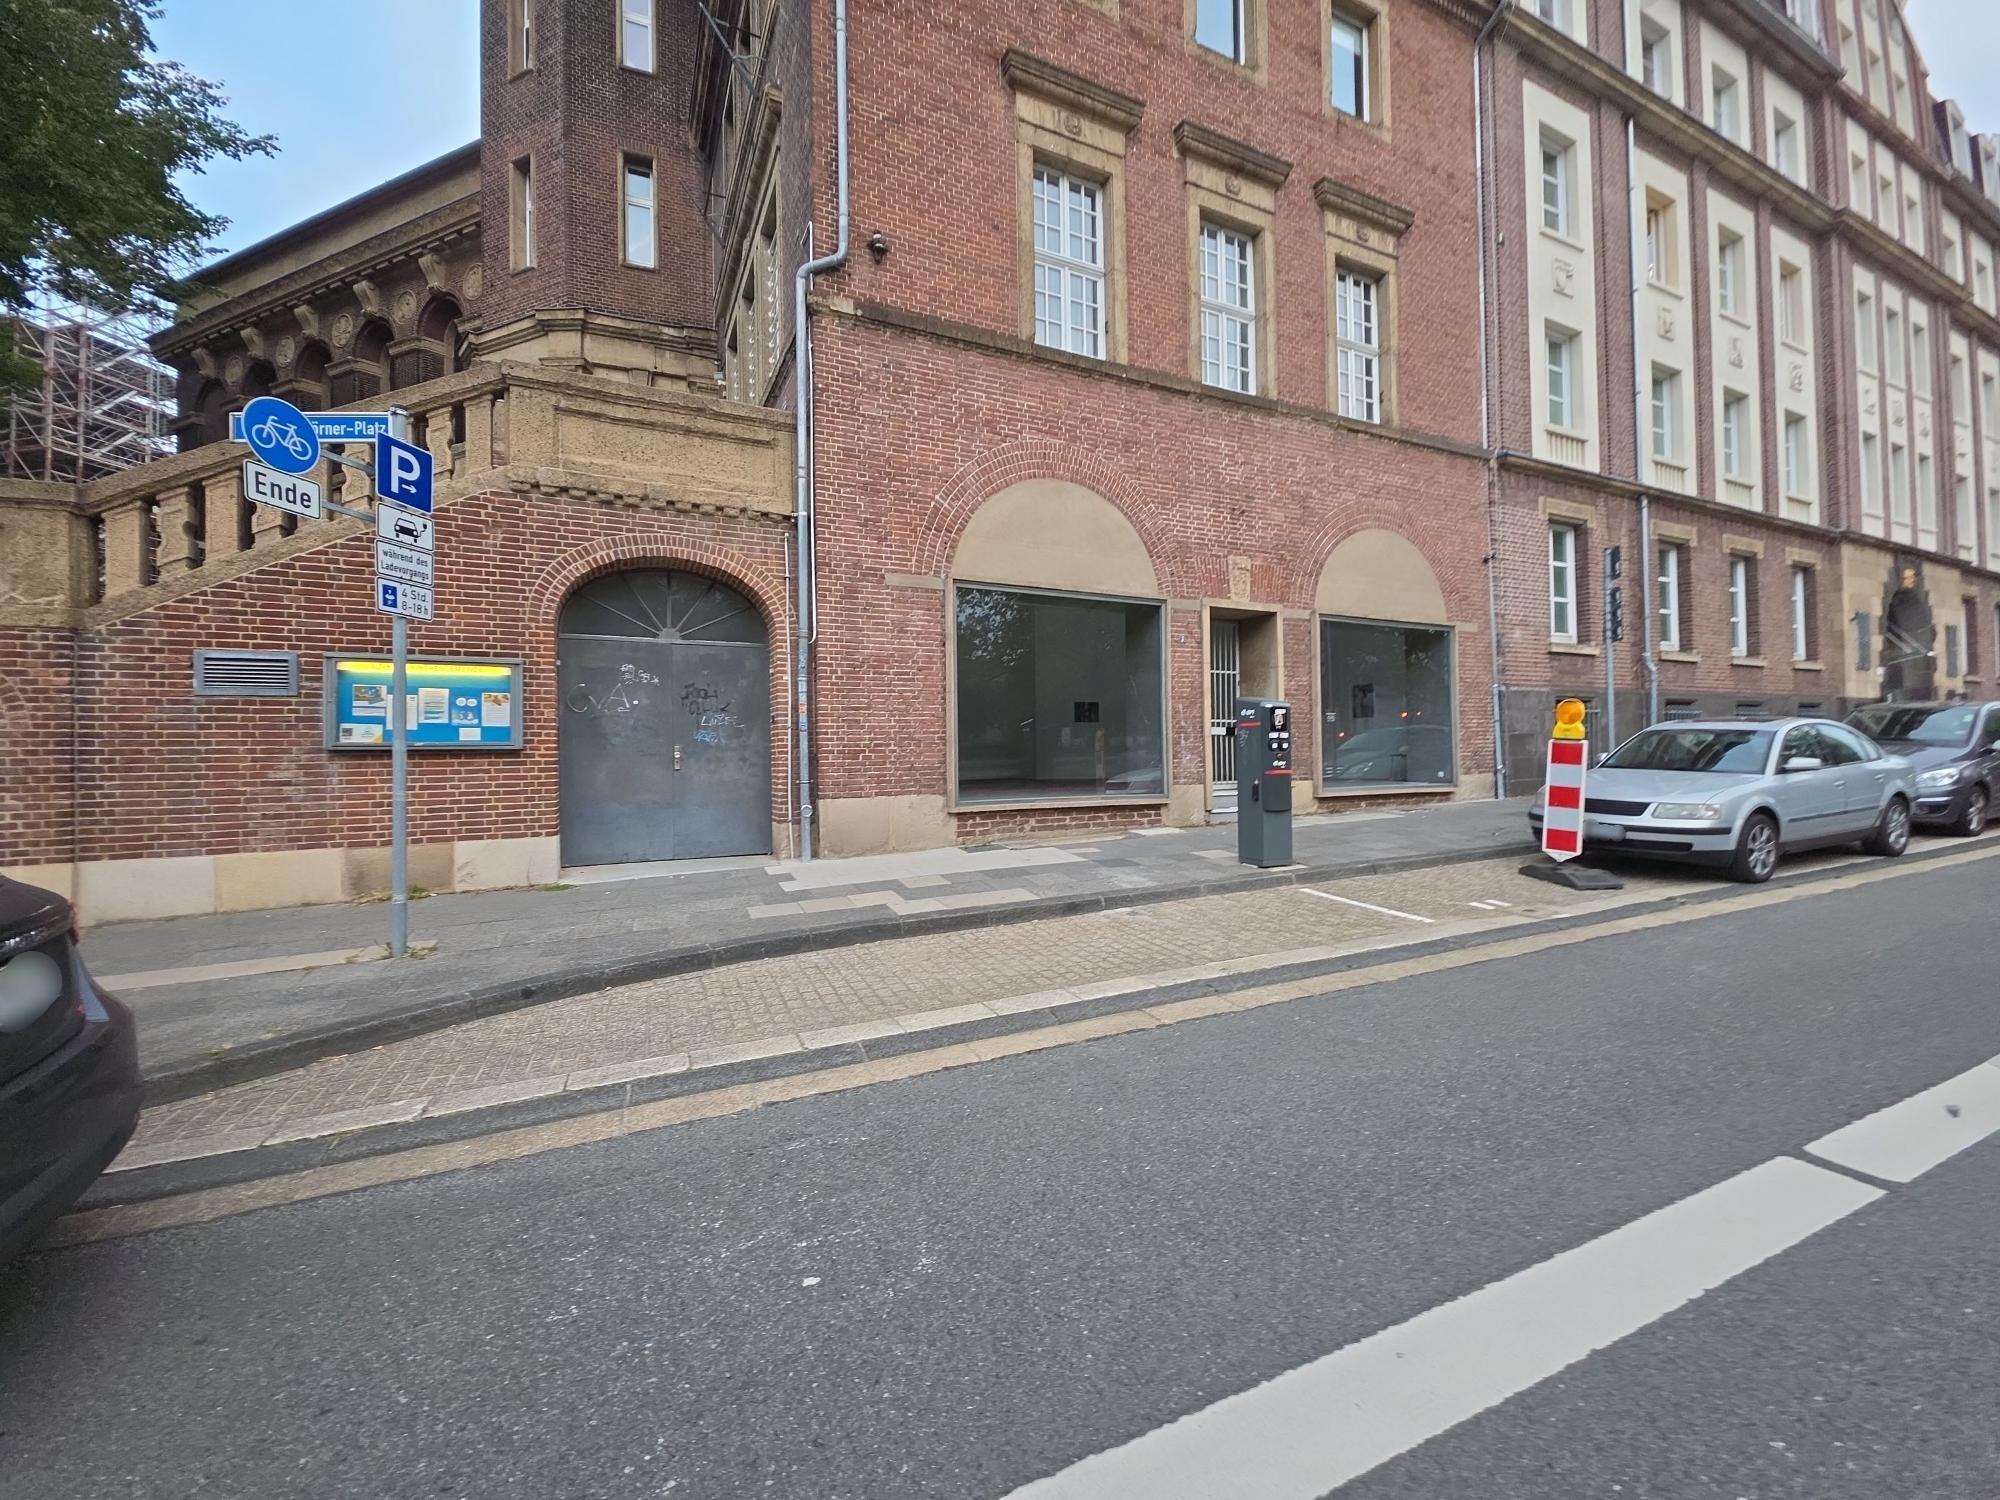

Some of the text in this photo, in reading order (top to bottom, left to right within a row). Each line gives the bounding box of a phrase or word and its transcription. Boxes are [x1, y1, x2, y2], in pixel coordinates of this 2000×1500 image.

[311, 420, 386, 436] örner-Platz
[390, 445, 421, 494] P
[254, 471, 312, 509] Ende
[382, 549, 428, 567] während des
[380, 560, 429, 581] Ladevorgangs
[401, 588, 429, 603] 4 Std.
